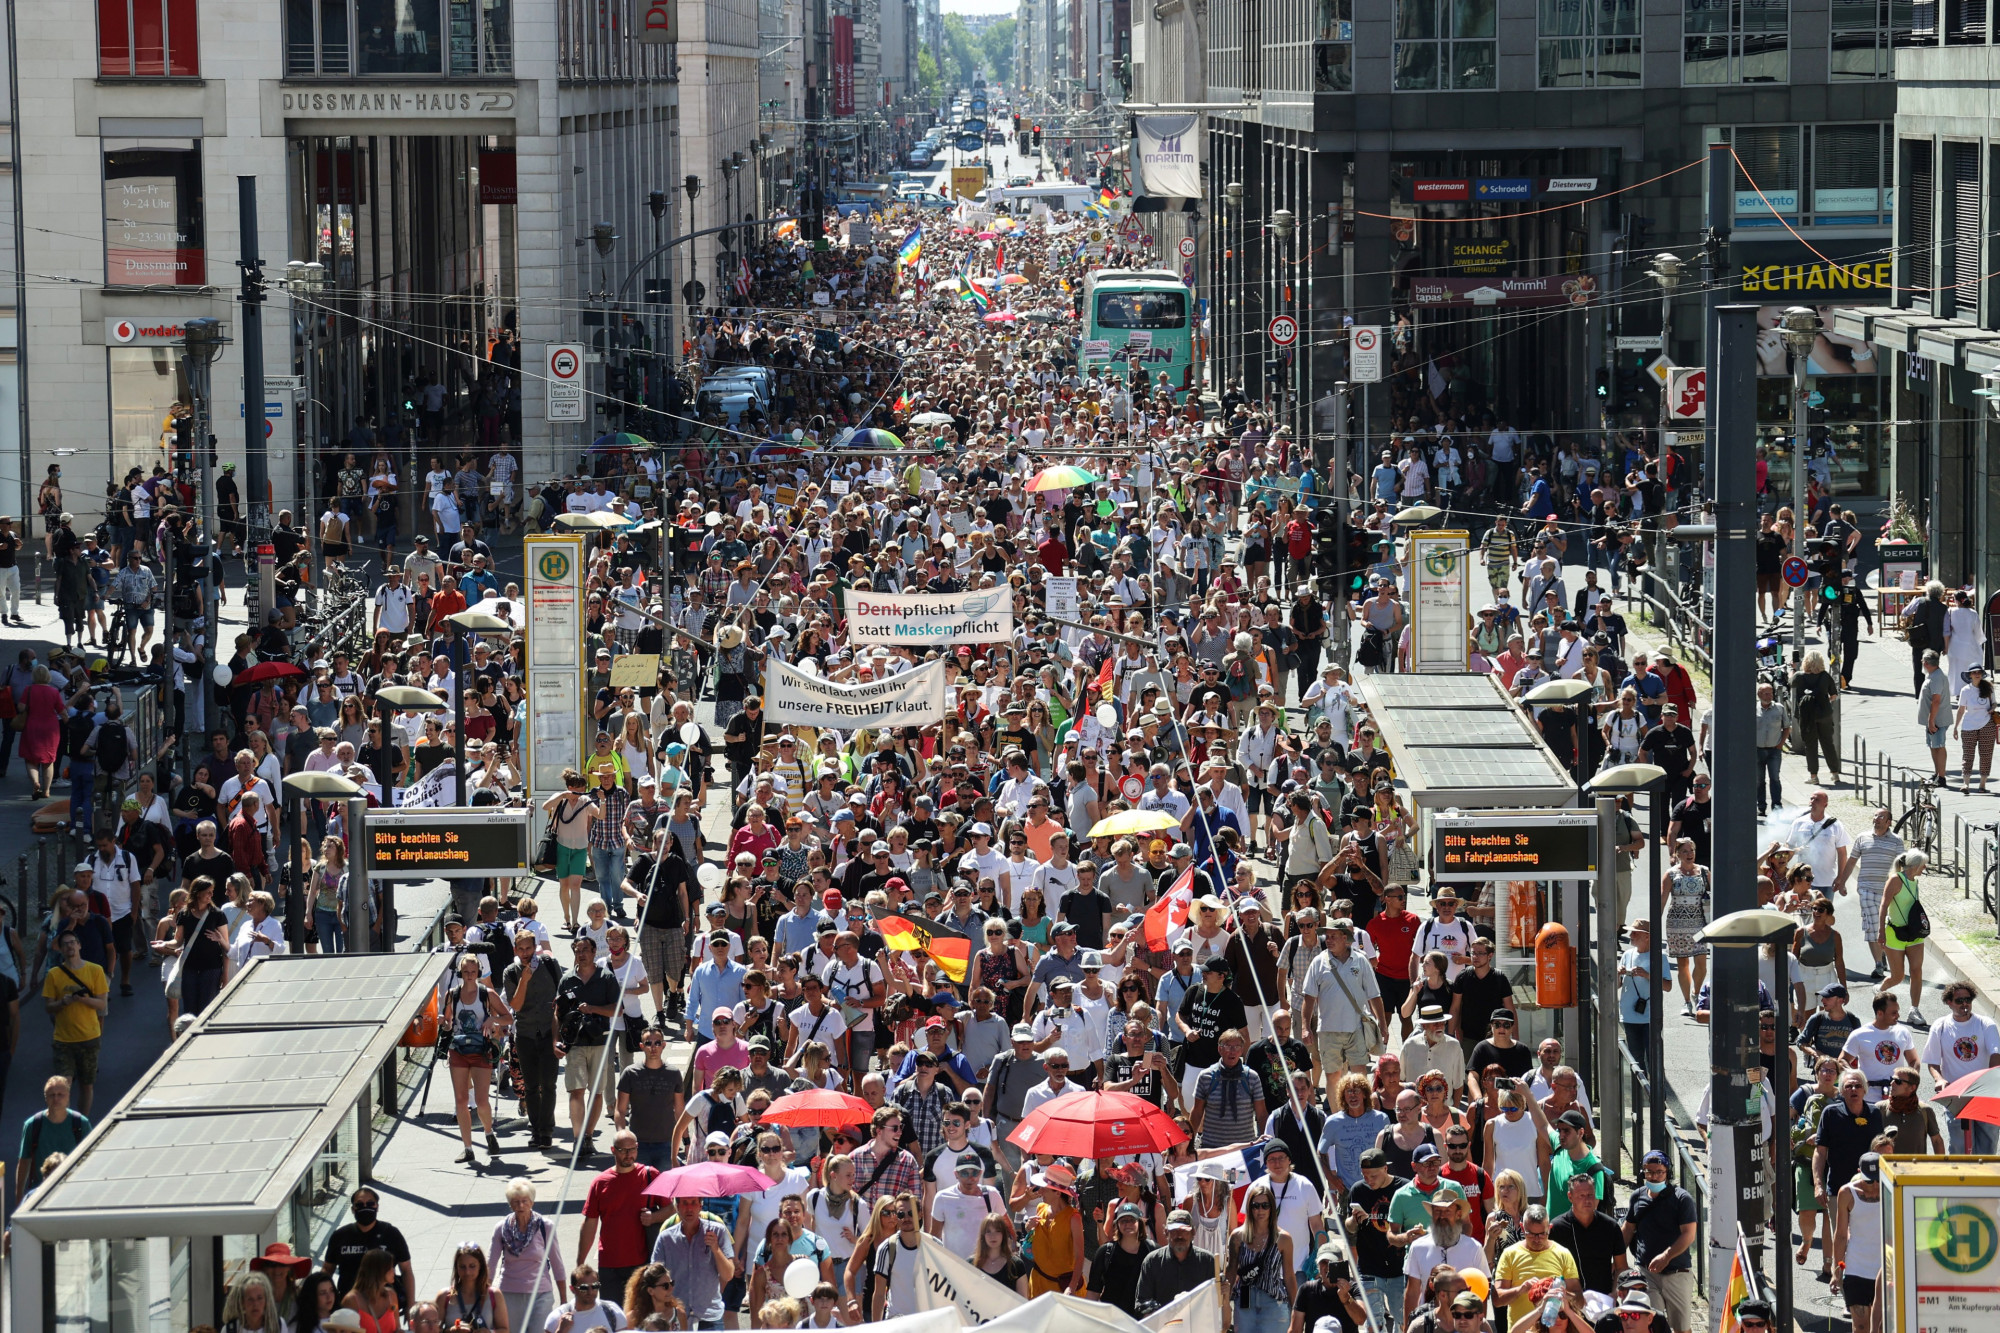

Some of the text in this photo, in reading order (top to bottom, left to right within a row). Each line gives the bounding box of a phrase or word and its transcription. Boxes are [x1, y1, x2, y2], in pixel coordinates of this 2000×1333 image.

[283, 93, 471, 111] DUSSMANN-HAUS
[1145, 153, 1194, 163] MARITIM
[1417, 183, 1465, 191] westermann
[1490, 184, 1528, 193] Schroedel
[1552, 181, 1592, 190] Diesterweg
[152, 199, 171, 208] Uhr
[1738, 196, 1794, 207] servento
[1818, 196, 1875, 204] personalservice
[123, 218, 136, 227] Sa
[1182, 243, 1193, 253] 30
[126, 259, 188, 270] Dussmann
[1415, 285, 1442, 294] berlin
[1502, 280, 1547, 291] Mmmh!
[1416, 294, 1442, 303] tapas
[1275, 323, 1292, 337] 30
[264, 379, 294, 388] heenstraße
[547, 557, 561, 574] H
[857, 601, 955, 619] Denkpflicht
[858, 620, 999, 637] statt Maskenpflicht
[781, 674, 907, 698] Wir sind laut, weil ihr
[778, 700, 932, 716] unsere FREIHEIT klaut.
[375, 832, 458, 844] Bitte beachten Sie
[1445, 834, 1529, 846] Bitte beachten Sie
[376, 849, 469, 862] den Fahrplanaushang
[1445, 851, 1539, 865] den Fahrplanaushang
[1192, 1003, 1221, 1017] Merkel
[1202, 1018, 1215, 1027] der
[1119, 1067, 1130, 1075] GIB
[1946, 1220, 1980, 1258] H
[1926, 1297, 1940, 1305] M1
